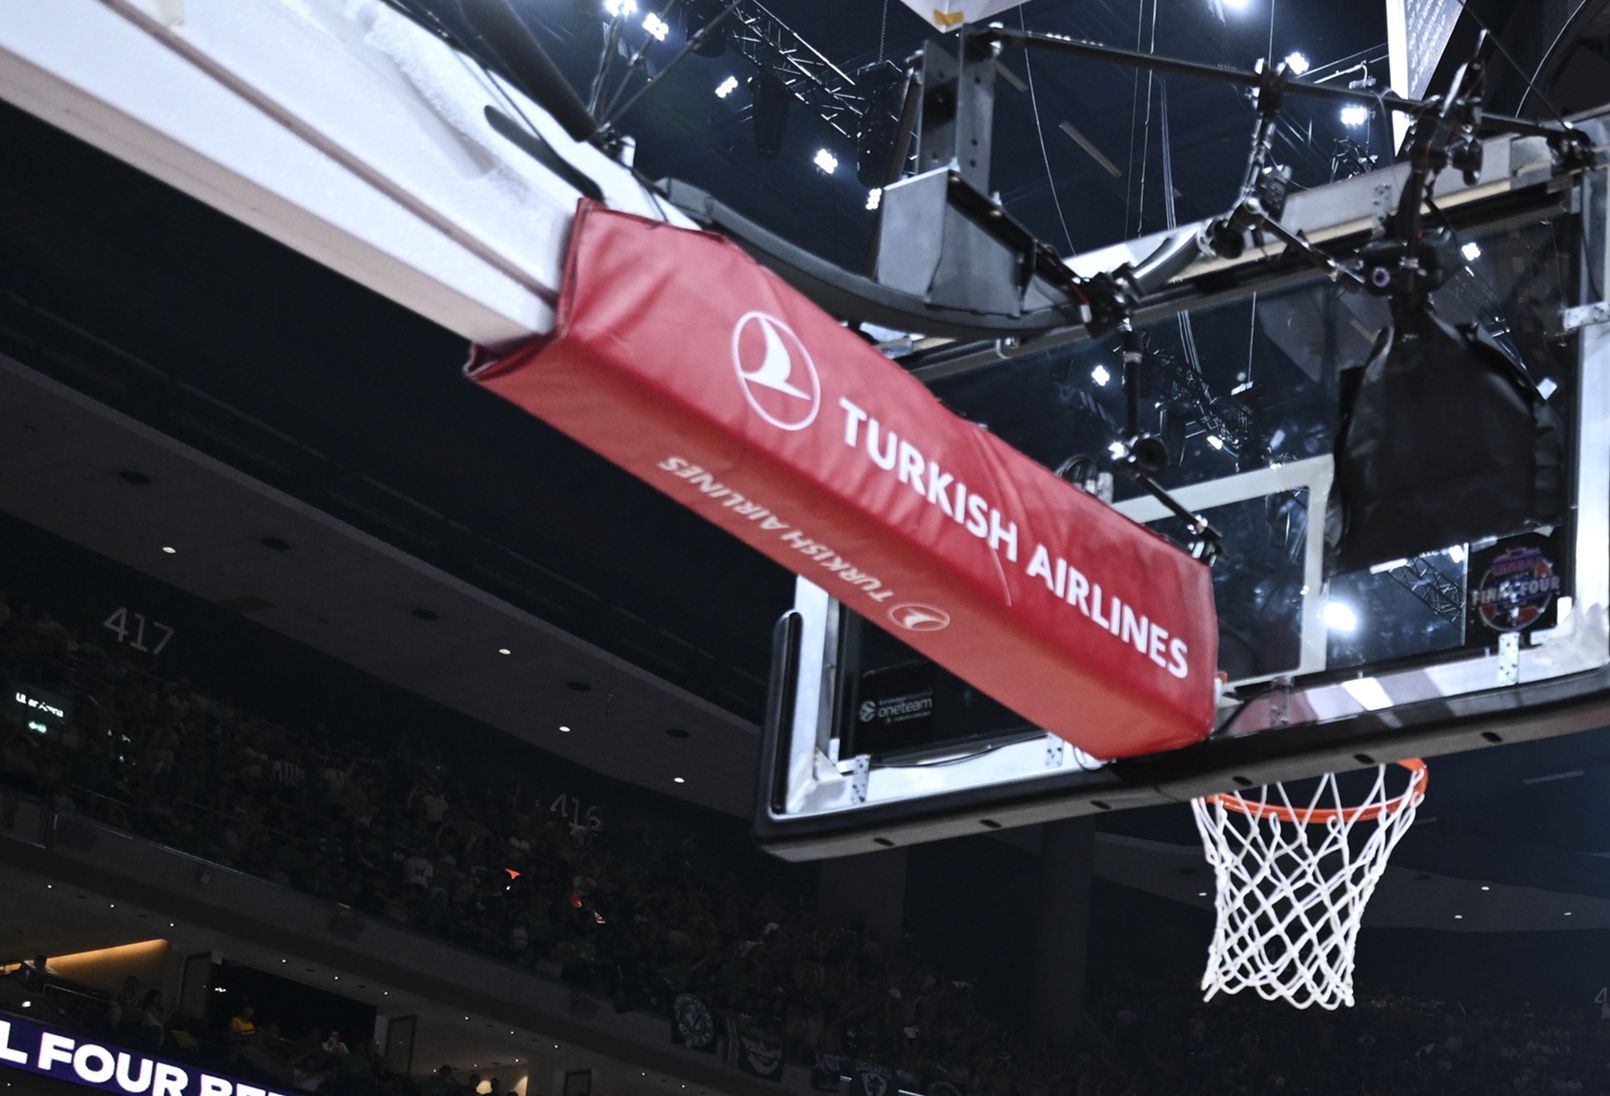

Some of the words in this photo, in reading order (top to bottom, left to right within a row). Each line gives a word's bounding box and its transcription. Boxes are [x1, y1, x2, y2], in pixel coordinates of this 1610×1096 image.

[656, 454, 784, 534] AIRLINES
[781, 524, 894, 604] TURKISH
[839, 397, 1019, 564] TURKISH
[1026, 545, 1189, 680] AIRLINES
[103, 606, 175, 655] 417
[878, 697, 933, 718] oneteam
